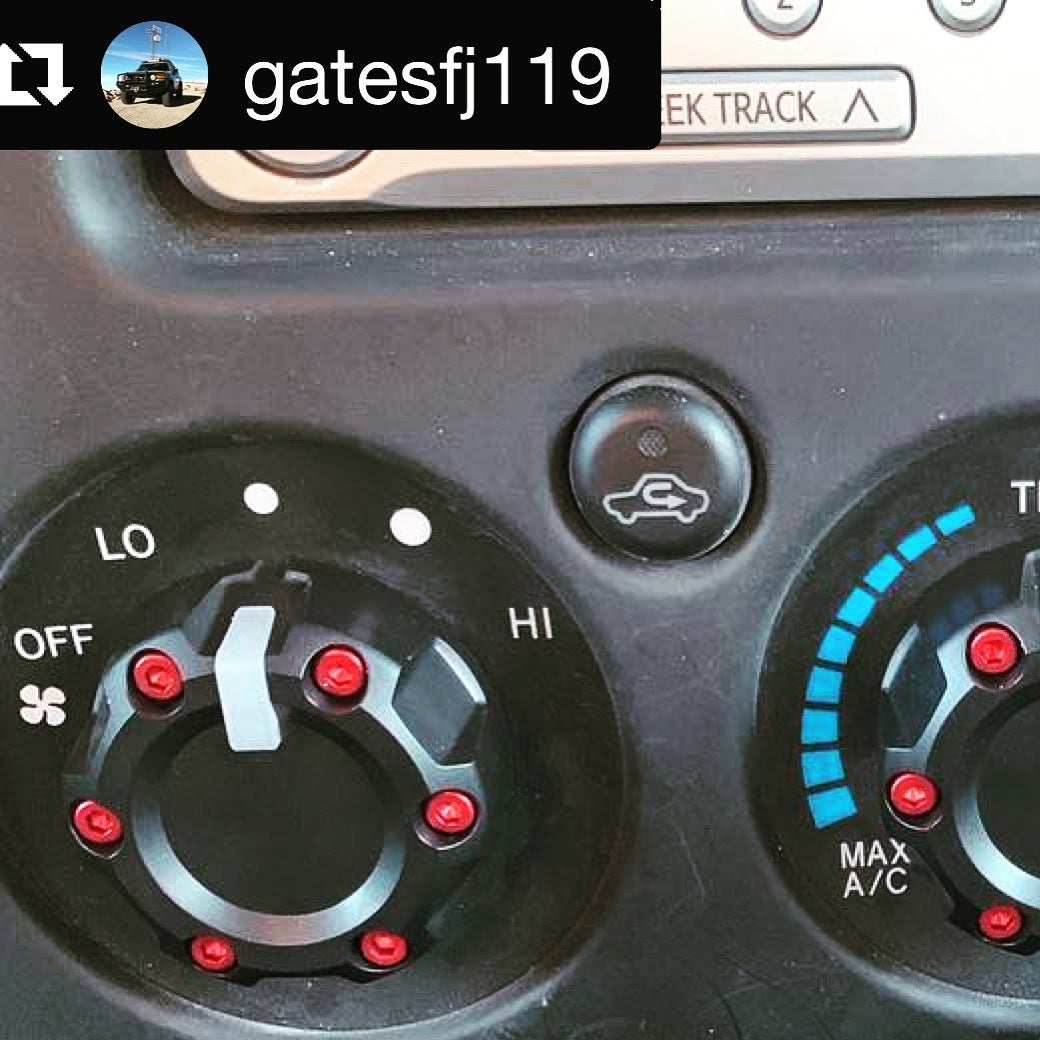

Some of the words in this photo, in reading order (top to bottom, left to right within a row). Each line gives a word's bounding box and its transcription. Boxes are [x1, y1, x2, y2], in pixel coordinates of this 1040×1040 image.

[661, 94, 706, 125] EK
[713, 90, 818, 124] TRACK
[95, 523, 156, 561] LO
[508, 606, 553, 639] HI
[13, 623, 93, 660] OFF
[840, 837, 911, 869] MAX
[842, 867, 908, 898] A/C
